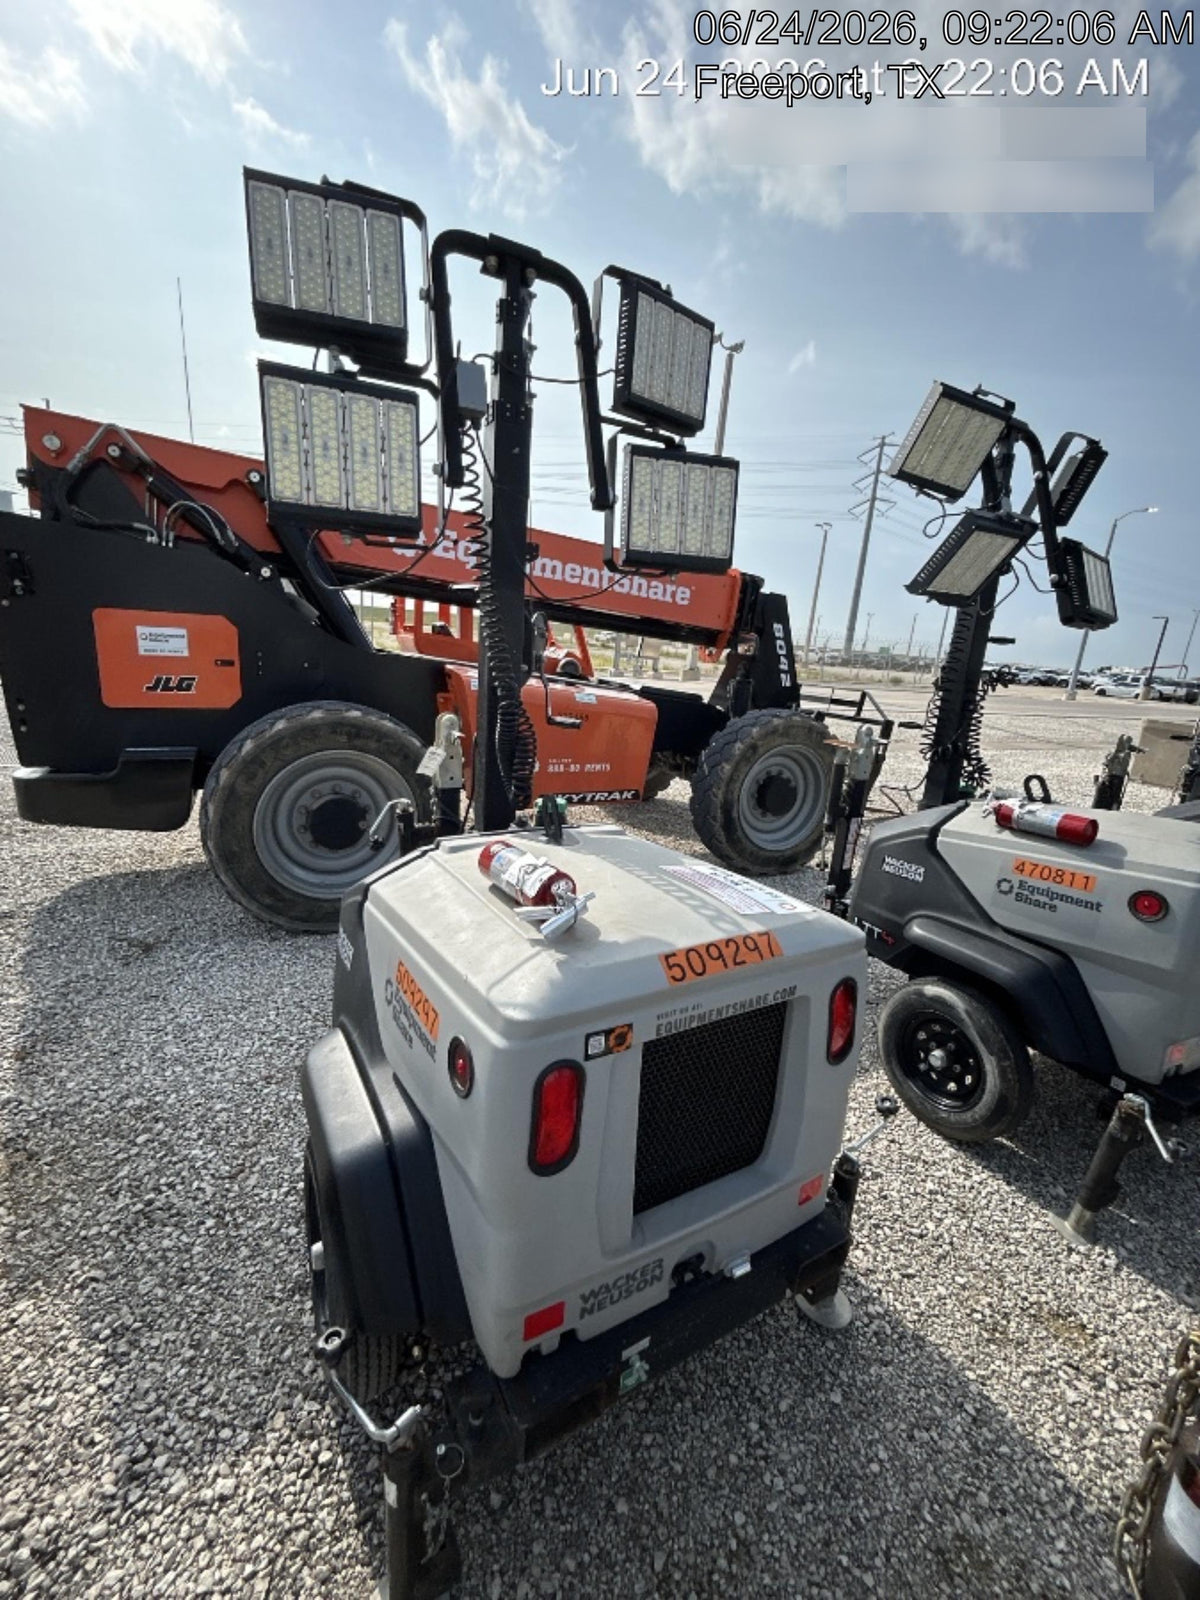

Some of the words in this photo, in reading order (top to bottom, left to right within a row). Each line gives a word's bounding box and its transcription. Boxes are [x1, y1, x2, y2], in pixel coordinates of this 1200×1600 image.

[432, 529, 691, 606] EqmentShare
[773, 623, 791, 687] 8042
[143, 674, 199, 694] JLG
[554, 790, 636, 803] KYTRAK
[1014, 861, 1091, 891] 470811
[1016, 880, 1104, 913] Equipment
[1014, 892, 1058, 913] Share
[664, 931, 775, 983] 509297
[396, 960, 438, 1036] 509297
[655, 985, 798, 1037] EQUIPMENTSHARE.COM
[579, 1258, 664, 1305] WACKER
[579, 1274, 663, 1320] NEUSON
